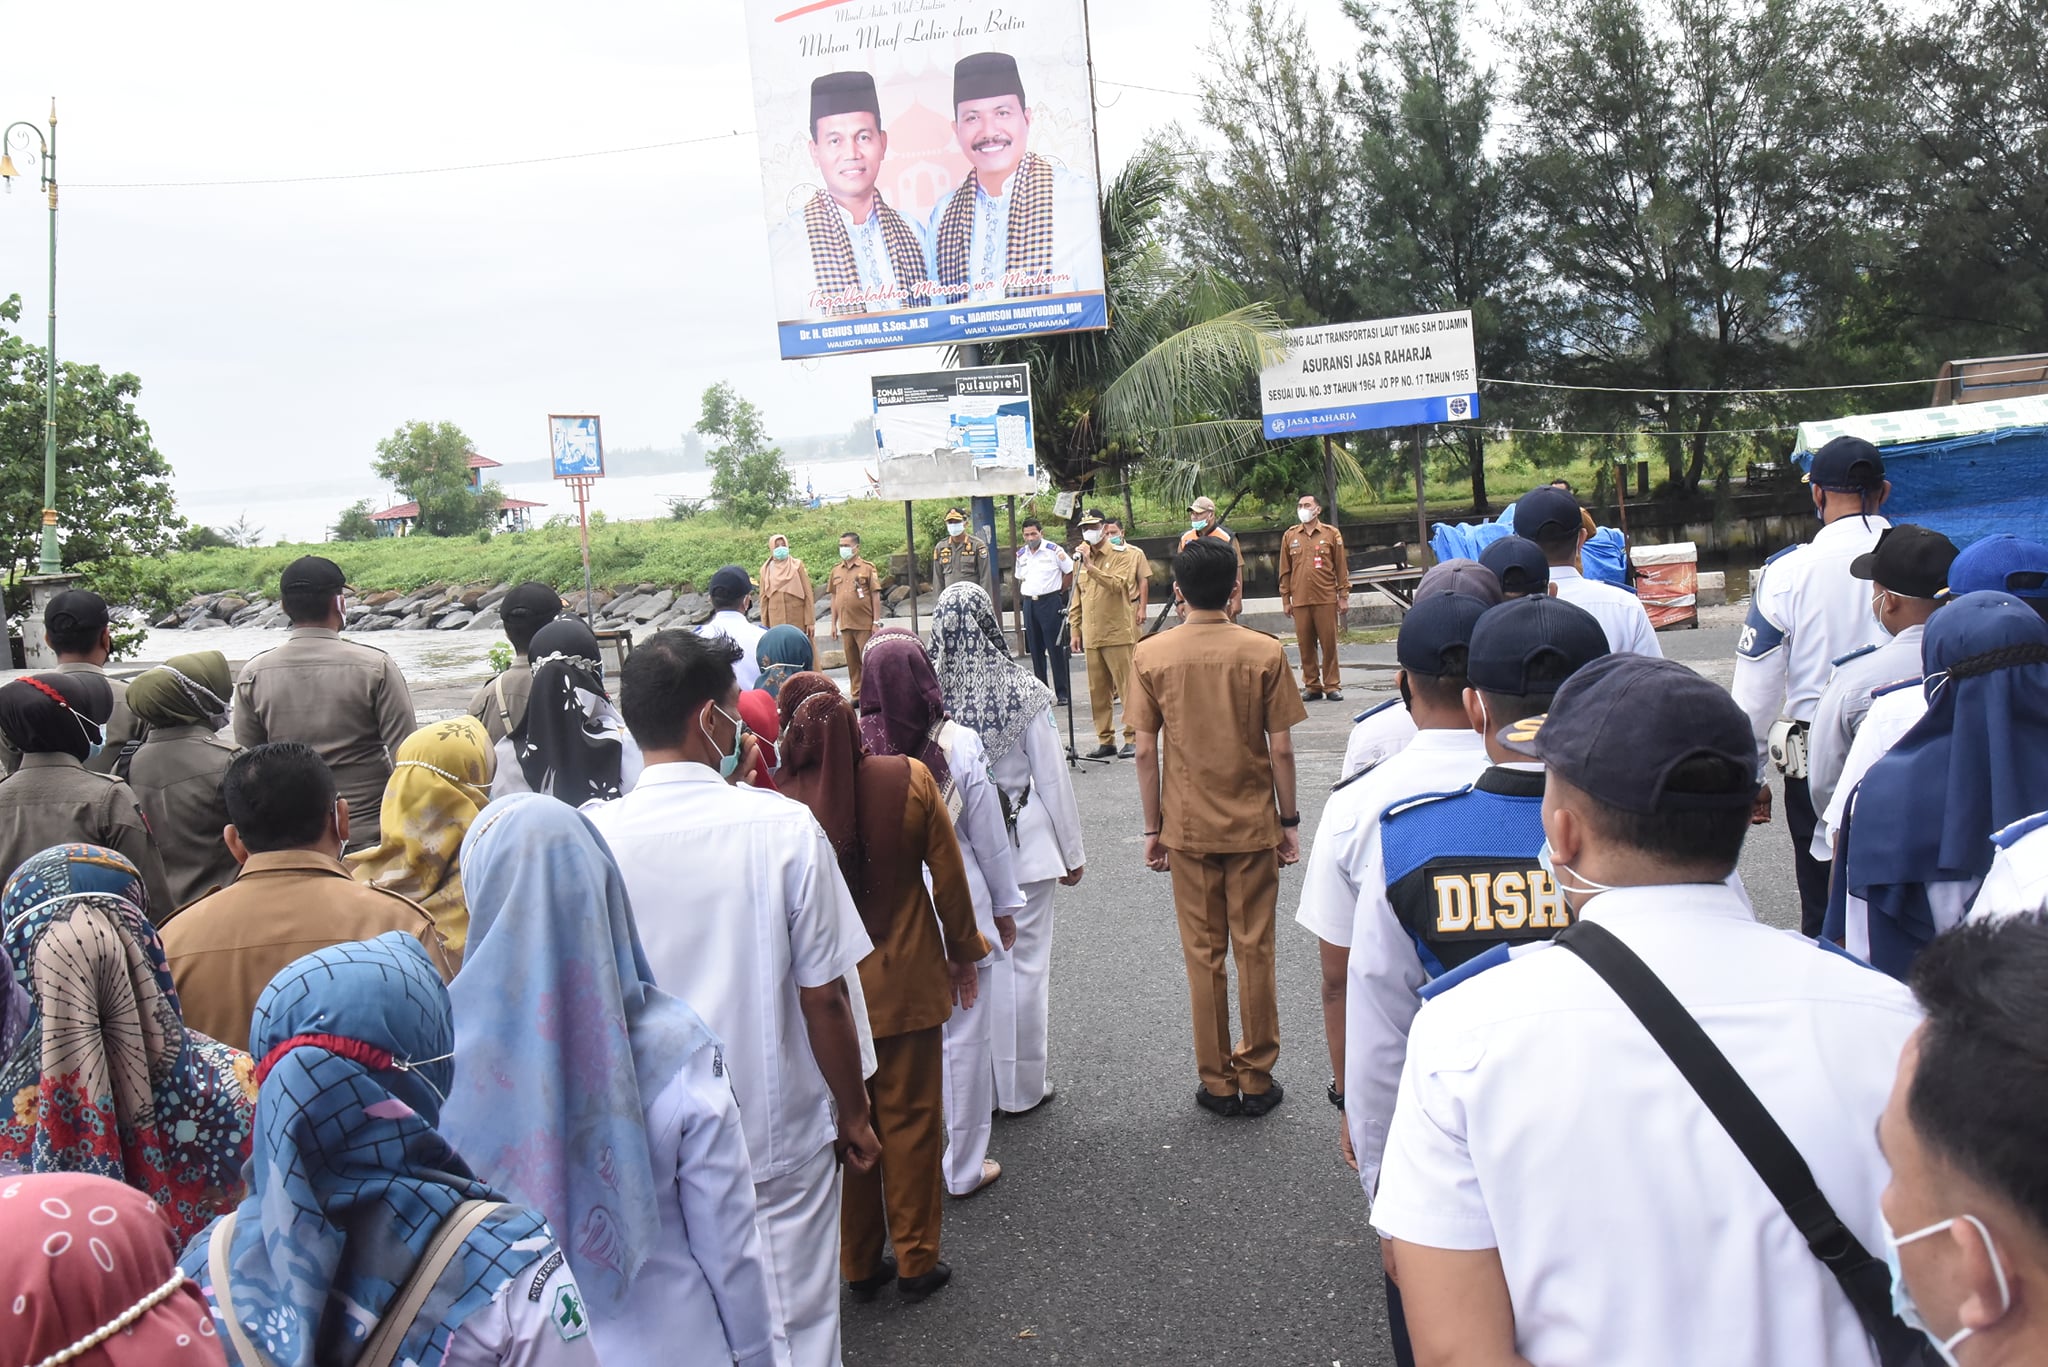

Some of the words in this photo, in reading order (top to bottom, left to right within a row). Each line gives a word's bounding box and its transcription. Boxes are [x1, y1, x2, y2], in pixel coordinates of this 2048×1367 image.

[799, 33, 849, 57] Mohon
[856, 22, 903, 51] Maaf
[904, 18, 949, 44] Lahir
[953, 16, 978, 38] dan
[984, 8, 1025, 33] Batin
[911, 280, 970, 297] Minna
[974, 281, 995, 292] wa
[999, 269, 1071, 289] Minkum
[950, 314, 967, 326] Drs.
[967, 310, 1012, 325] MARDISON
[1012, 305, 1065, 320] MAHYUDDIN,
[1065, 302, 1082, 315] MM
[964, 326, 988, 335] WAKIL
[989, 322, 1028, 334] WALIKOTA
[1028, 318, 1070, 330] PARIAMAN
[800, 329, 812, 341] Dr.
[812, 328, 821, 340] H.
[822, 324, 853, 339] GENIUS
[826, 338, 864, 350] WALIKOTA
[864, 334, 904, 346] PARIAMAN
[1306, 333, 1324, 347] ALAT
[1325, 327, 1379, 345] TRANSPORTASI
[1380, 325, 1398, 338] LAUT
[1400, 322, 1420, 335] YANG
[1422, 319, 1436, 333] SAH
[1438, 317, 1468, 331] DIJAMIN
[1302, 354, 1353, 374] ASURANSI
[1356, 351, 1382, 368] JASA
[1384, 345, 1432, 365] RAHARJA
[877, 387, 904, 398] ZONASI
[1268, 386, 1294, 401] SESUAI
[1295, 385, 1308, 399] UU.
[1309, 384, 1322, 397] NO.
[1323, 383, 1332, 396] 33
[1333, 380, 1358, 395] TAHUN
[1359, 379, 1376, 391] 1964
[1379, 377, 1388, 390] JO
[1390, 376, 1399, 388] PP
[1401, 375, 1414, 387] NO.
[1416, 374, 1424, 386] 17
[1425, 371, 1450, 385] TAHUN
[1452, 368, 1470, 382] 1965
[1287, 417, 1310, 429] JASA
[1312, 411, 1357, 425] RAHARJA
[1434, 869, 1569, 933] DISH
